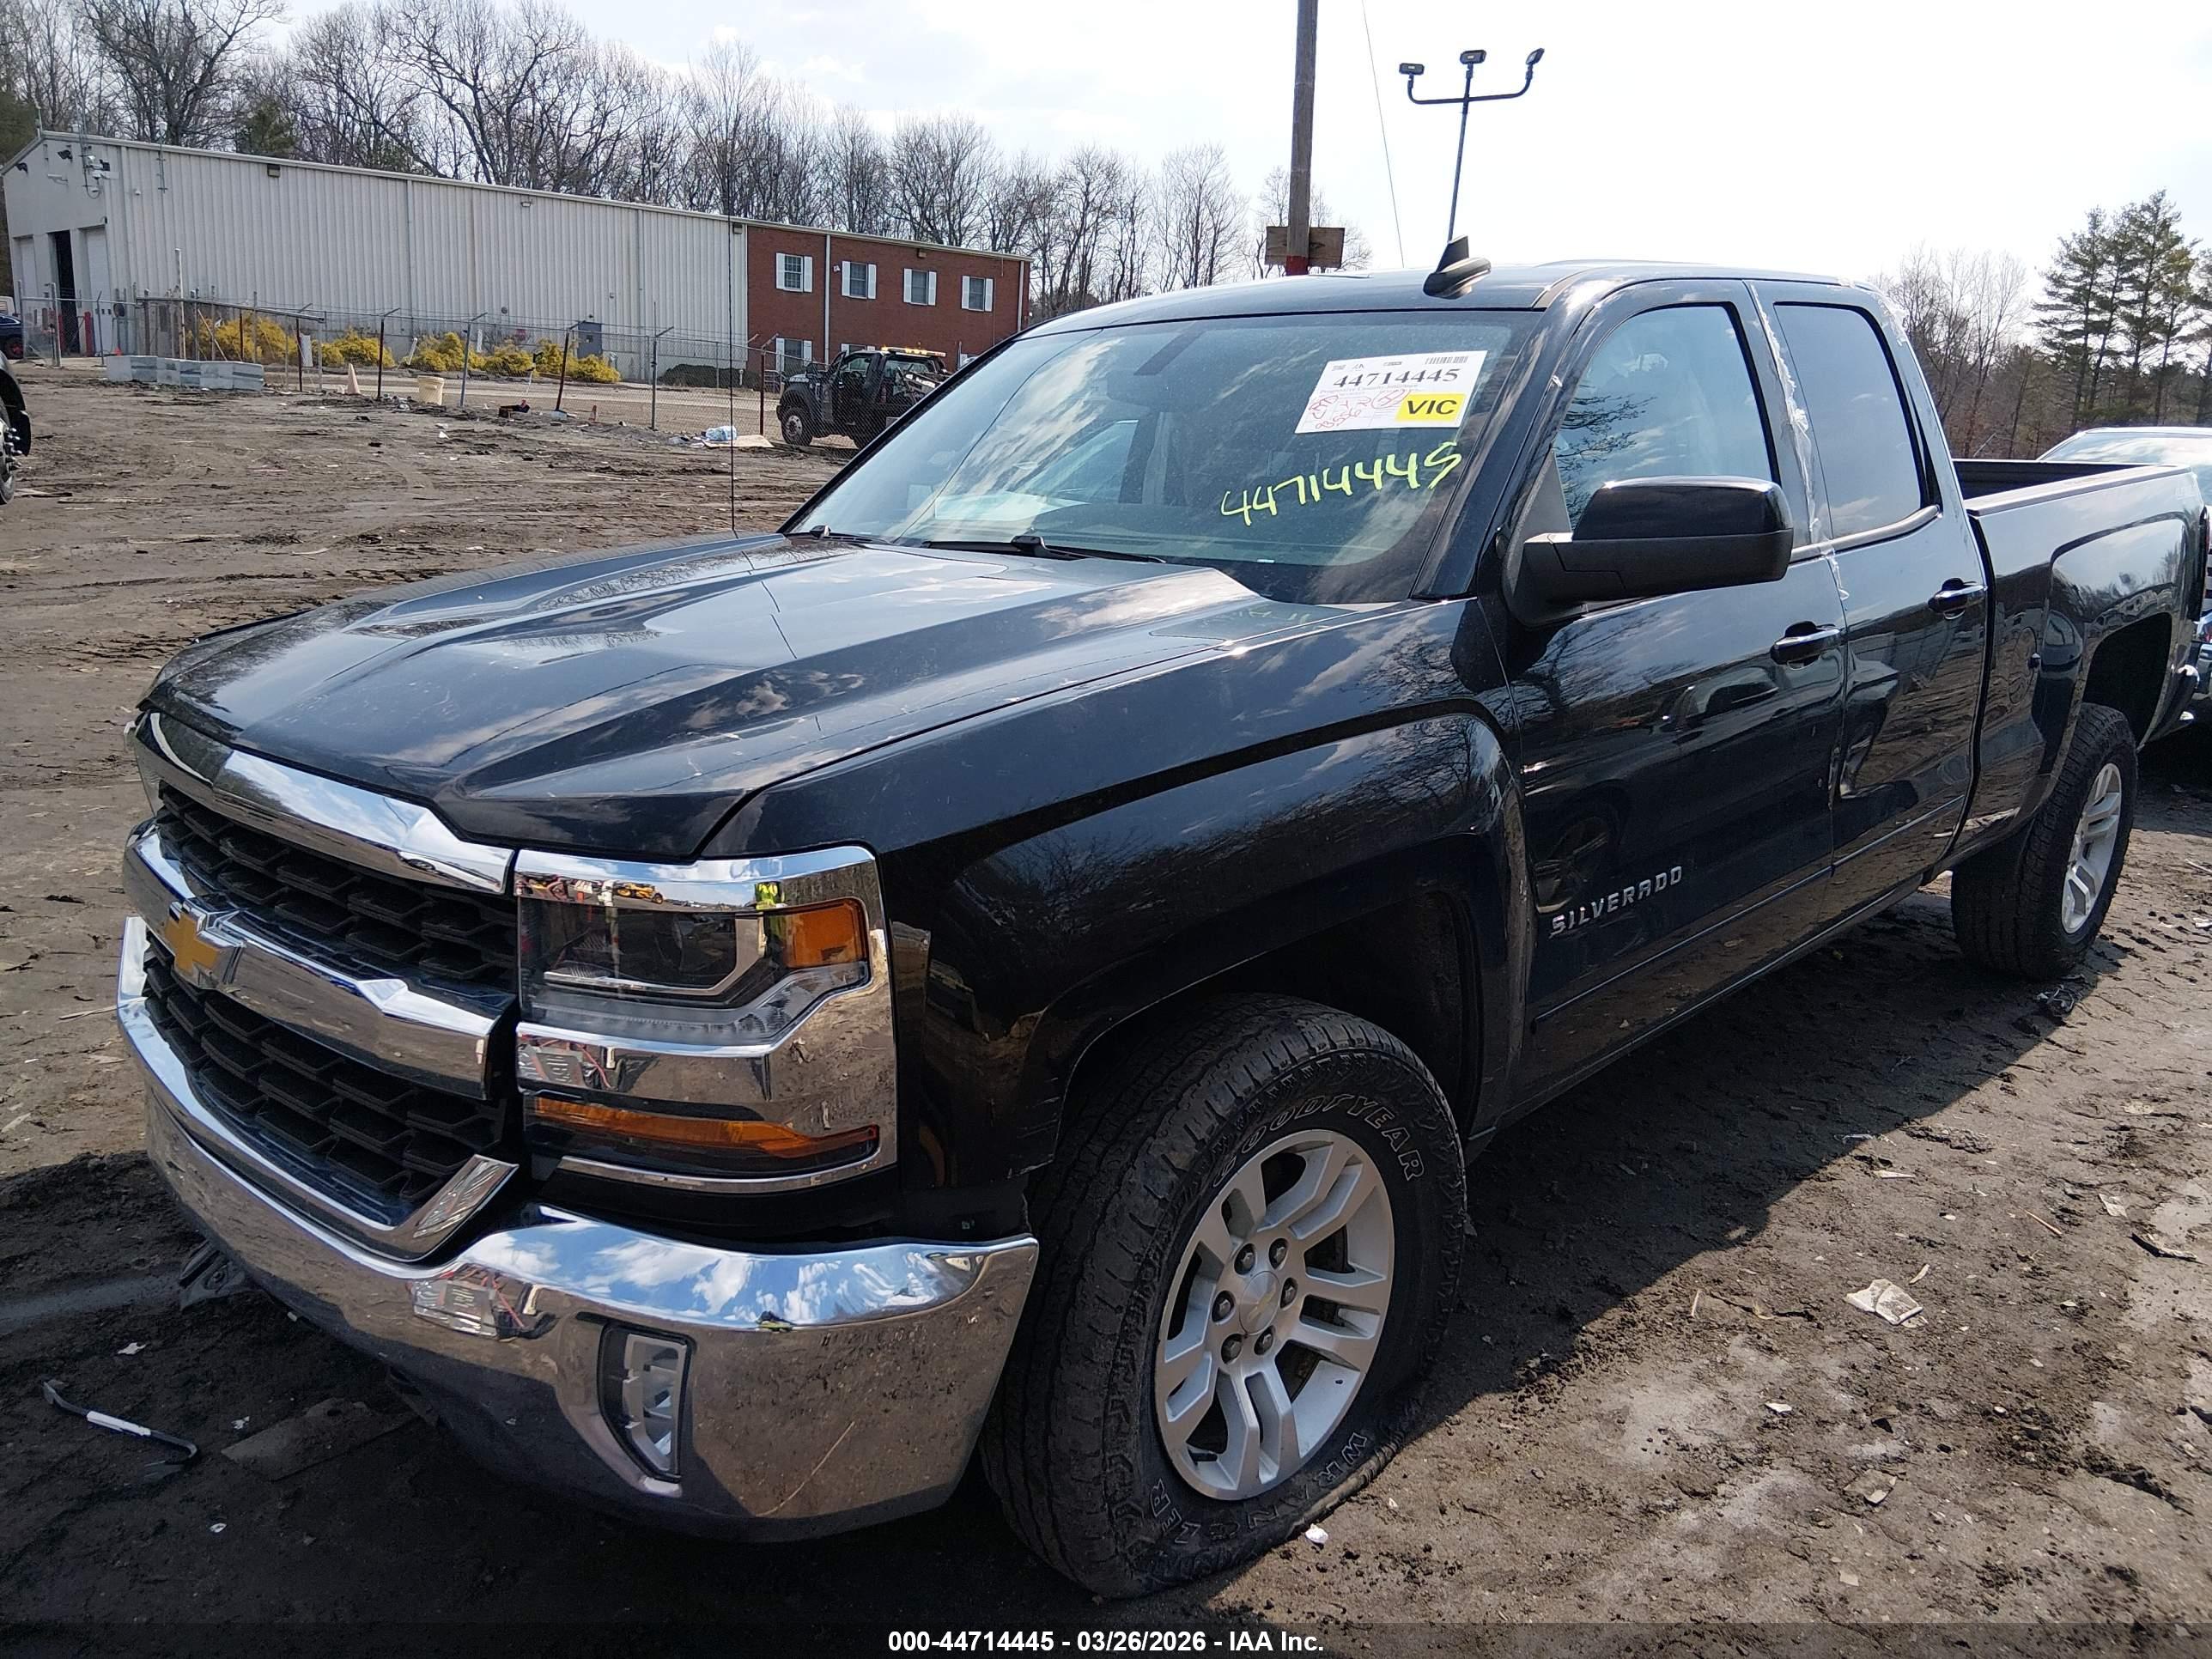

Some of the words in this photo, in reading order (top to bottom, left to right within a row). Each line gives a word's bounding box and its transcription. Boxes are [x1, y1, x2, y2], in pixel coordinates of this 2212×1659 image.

[1333, 368, 1462, 388] 44714445
[1407, 399, 1457, 415] VIC
[1220, 441, 1462, 526] 44714445
[1548, 866, 1682, 939] SILVERADO
[1213, 1093, 1425, 1188] GOODYEAR
